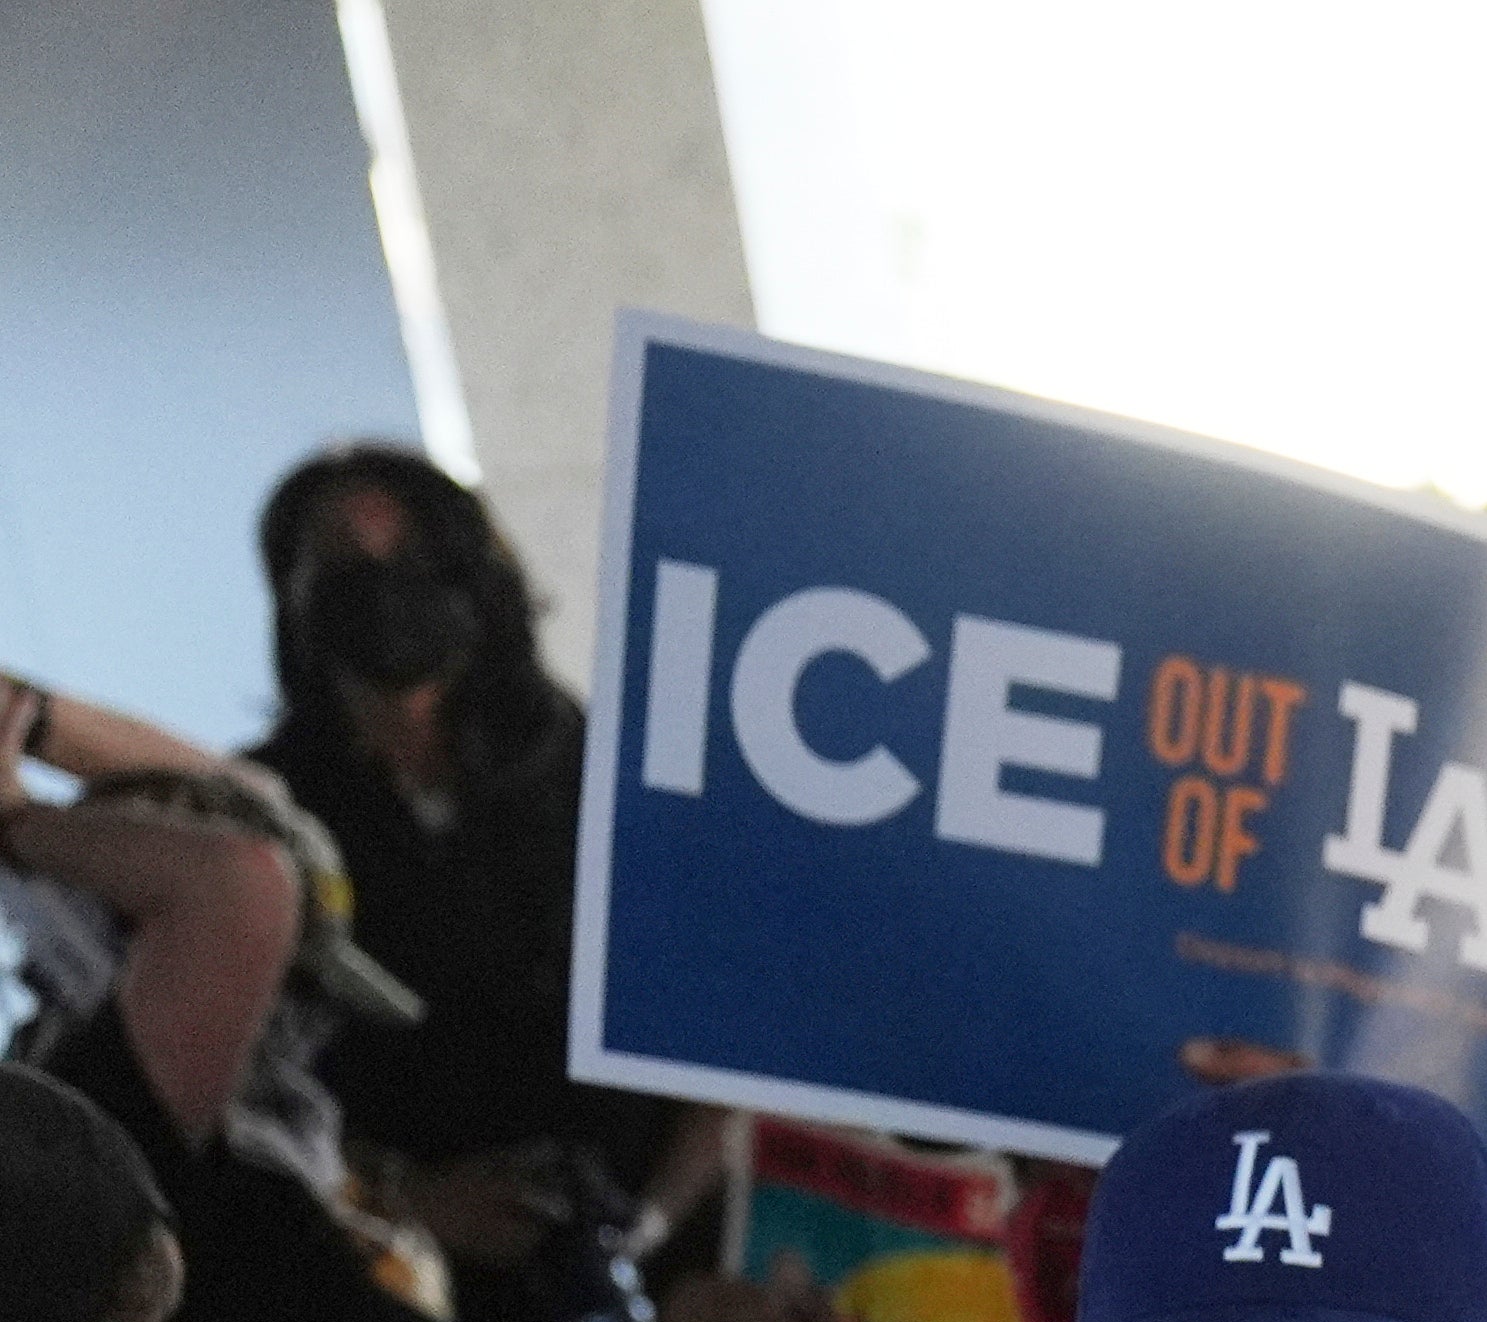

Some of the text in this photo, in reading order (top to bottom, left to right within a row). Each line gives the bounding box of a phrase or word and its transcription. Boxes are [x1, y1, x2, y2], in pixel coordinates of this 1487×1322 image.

[642, 558, 1123, 868] ICE
[1149, 654, 1308, 788] OUT
[1162, 775, 1268, 894] OF
[1215, 1130, 1331, 1267] LA
